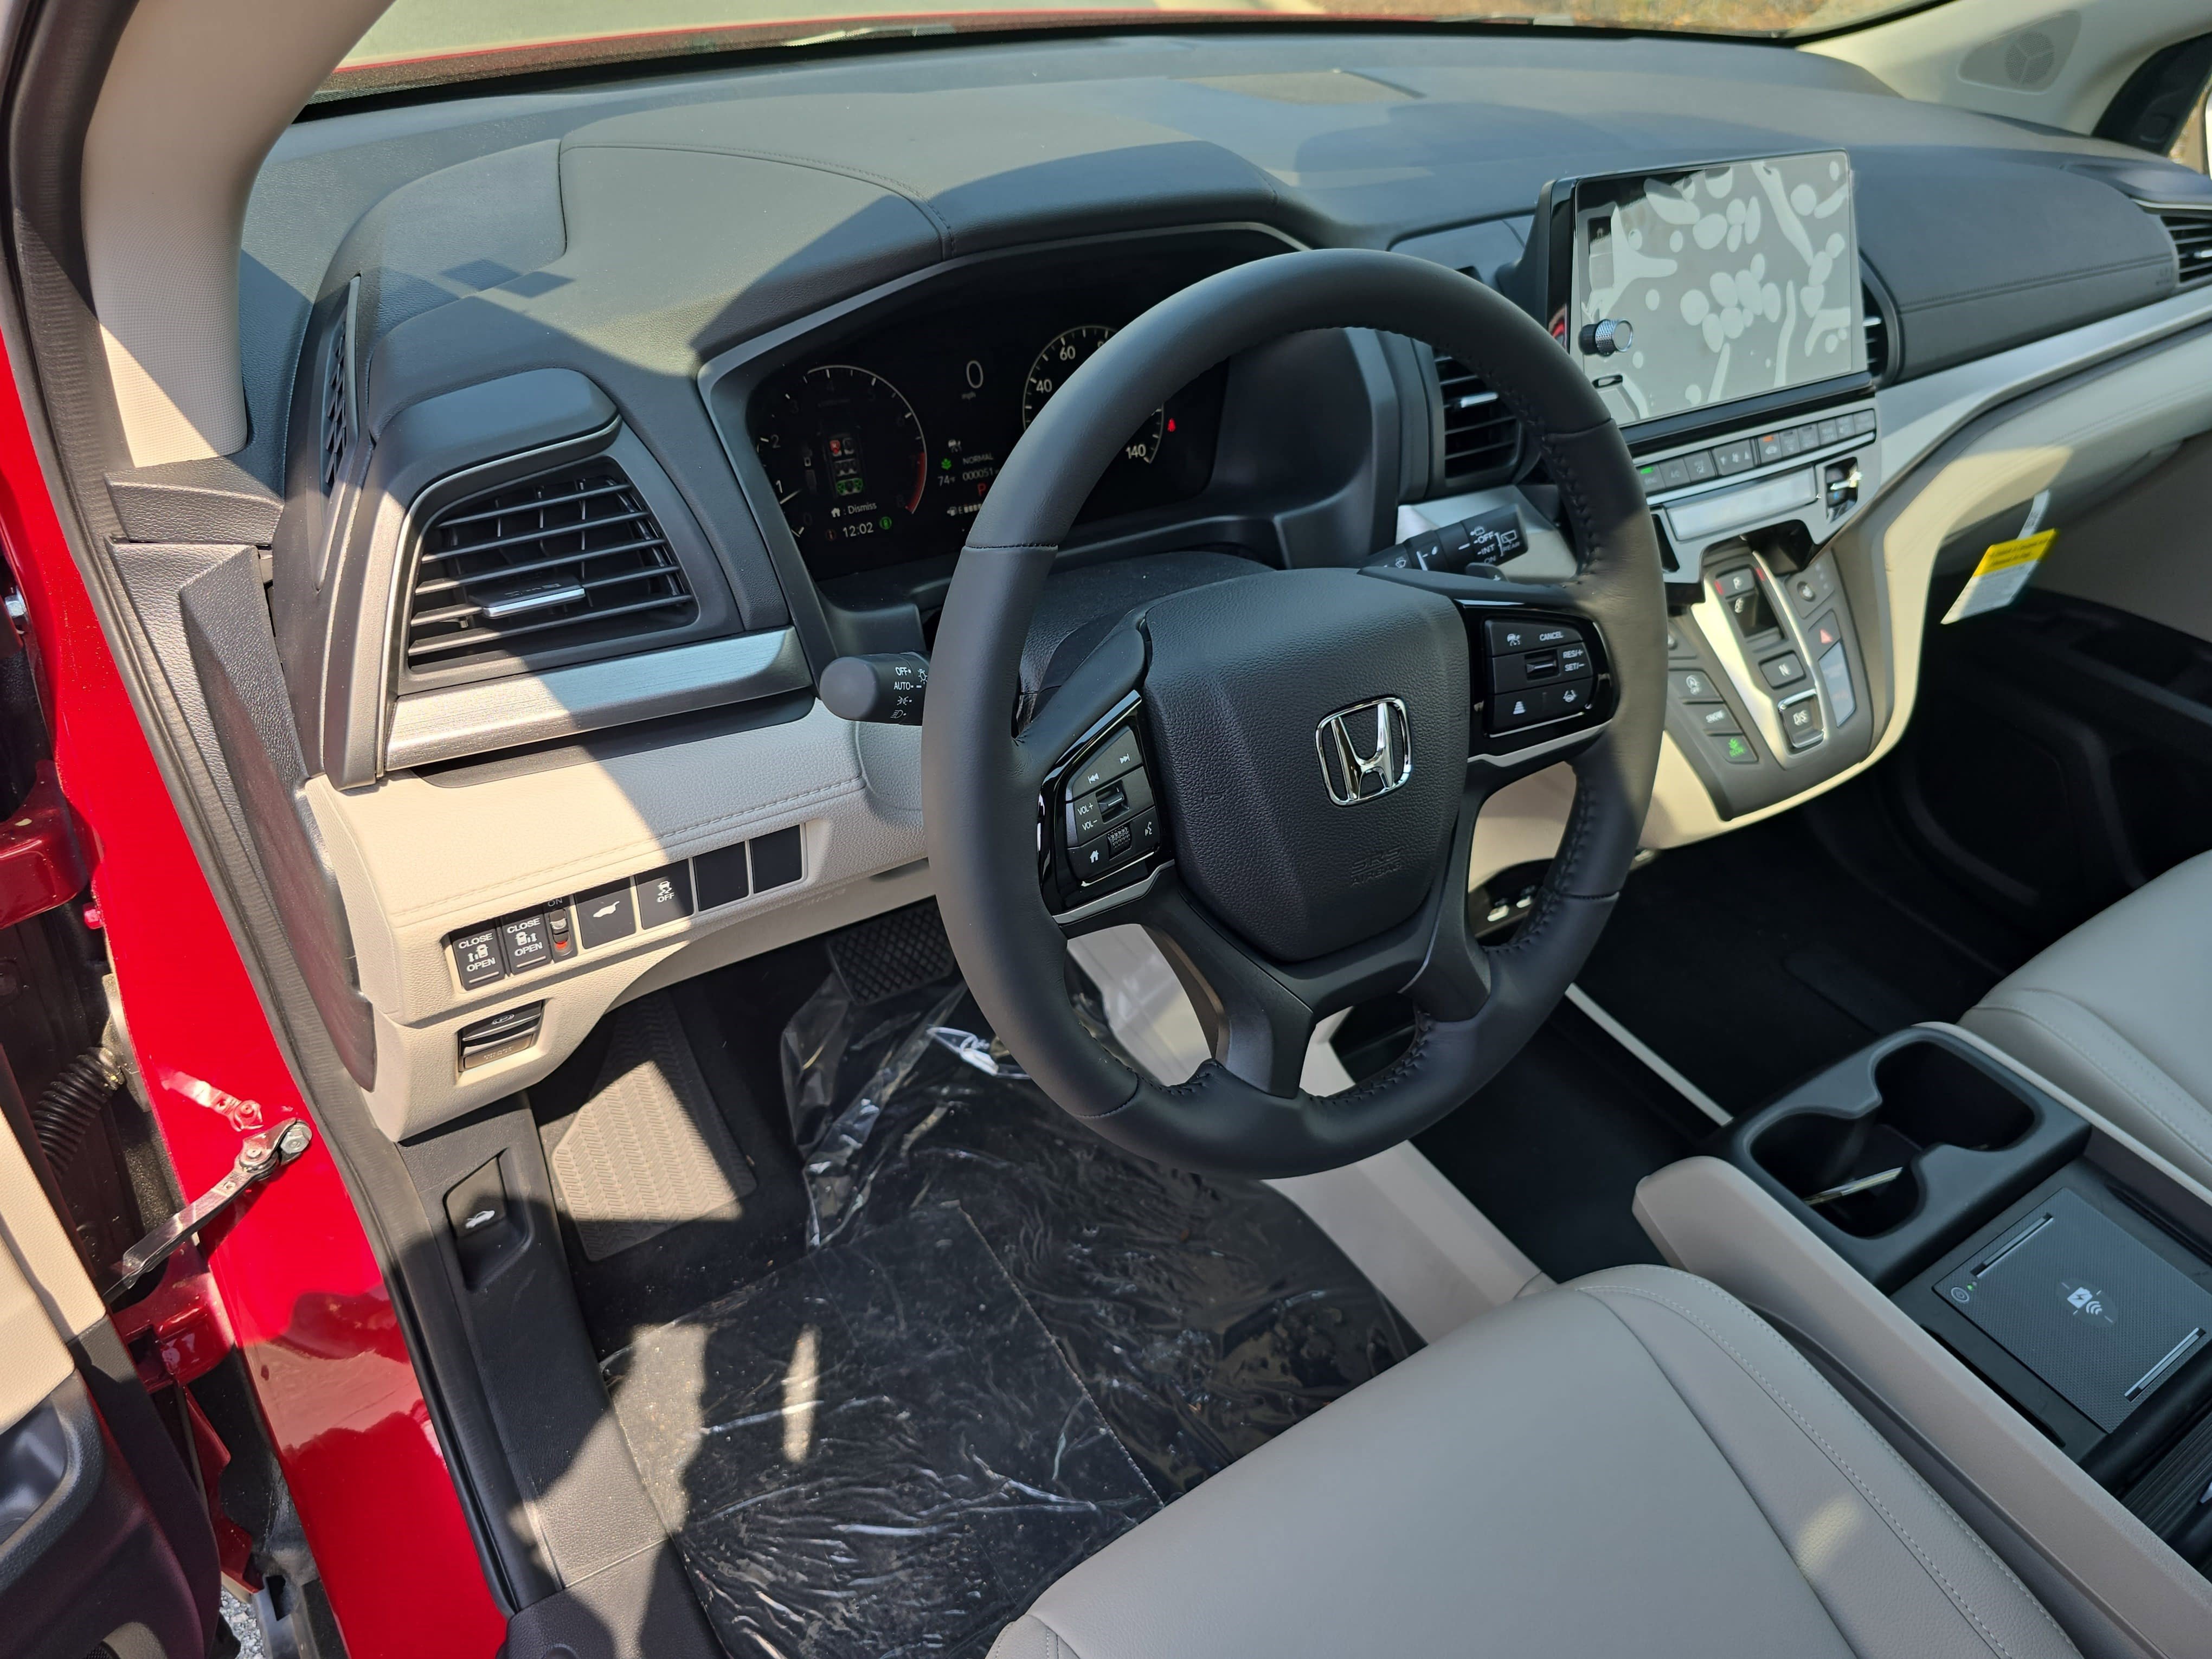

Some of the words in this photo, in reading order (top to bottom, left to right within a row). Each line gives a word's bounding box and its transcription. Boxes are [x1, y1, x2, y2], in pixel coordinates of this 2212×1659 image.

[1059, 345, 1076, 361] 60
[966, 359, 984, 389] 0
[1036, 378, 1052, 393] 40
[770, 434, 781, 449] 2
[962, 452, 994, 466] NORMAL
[1125, 443, 1147, 460] 140
[962, 467, 994, 481] 000051
[775, 479, 783, 494] 1
[977, 481, 988, 497] P
[847, 501, 878, 515] Dismiss
[842, 521, 874, 538] 12:02
[1477, 530, 1495, 544] OFF
[1481, 543, 1495, 555] INT
[1484, 555, 1497, 564] ON
[1539, 630, 1565, 642] CANCEL
[895, 667, 908, 676] OFF
[893, 681, 911, 691] AUTO
[546, 896, 563, 908] ON
[657, 892, 674, 903] OFF
[506, 917, 541, 935] CLOSE
[458, 933, 493, 949] CLOSE
[514, 941, 543, 957] OPEN
[466, 956, 496, 972] OPEN
